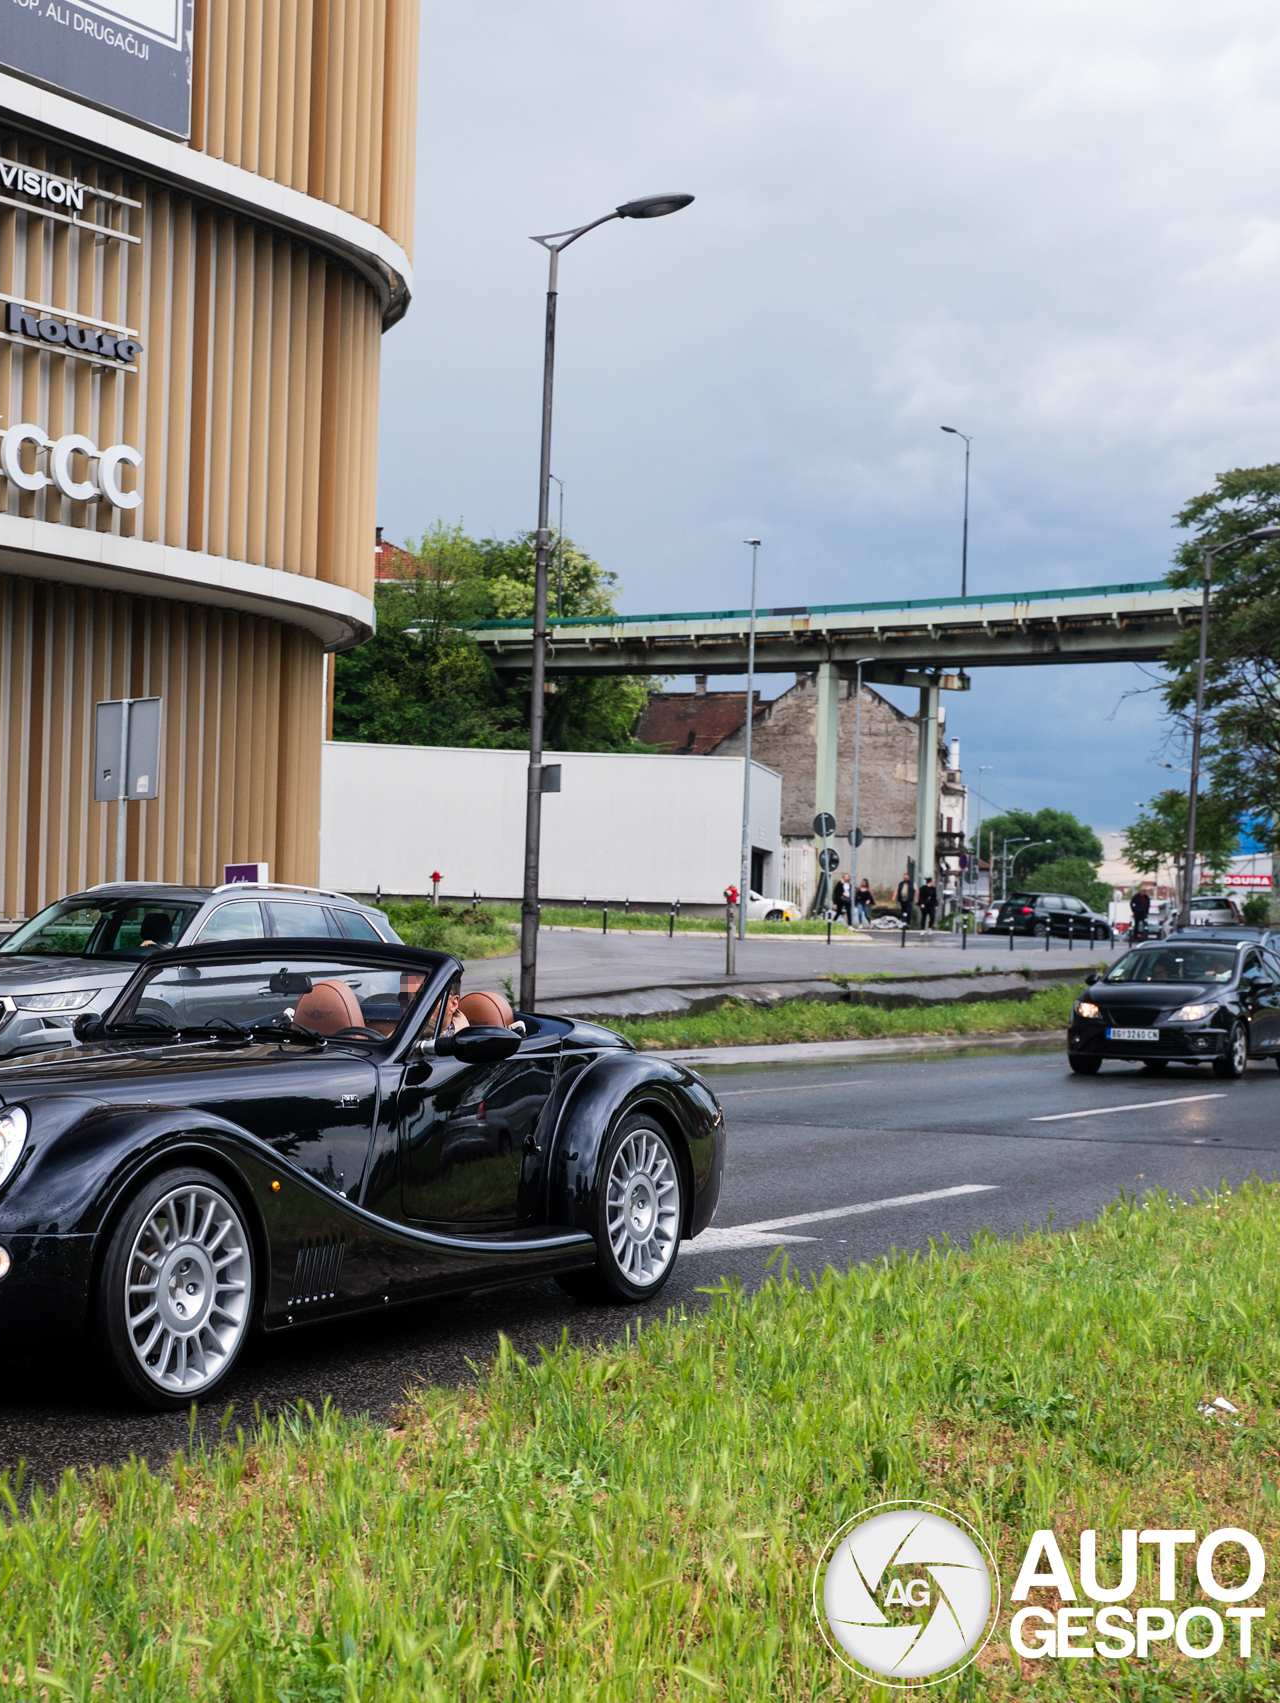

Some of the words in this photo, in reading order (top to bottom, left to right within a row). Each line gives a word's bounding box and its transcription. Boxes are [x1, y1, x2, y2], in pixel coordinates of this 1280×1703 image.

[46, 3, 69, 26] ALI
[73, 13, 149, 61] DRUGAČIJI
[5, 302, 144, 363] house
[0, 422, 143, 510] CCC
